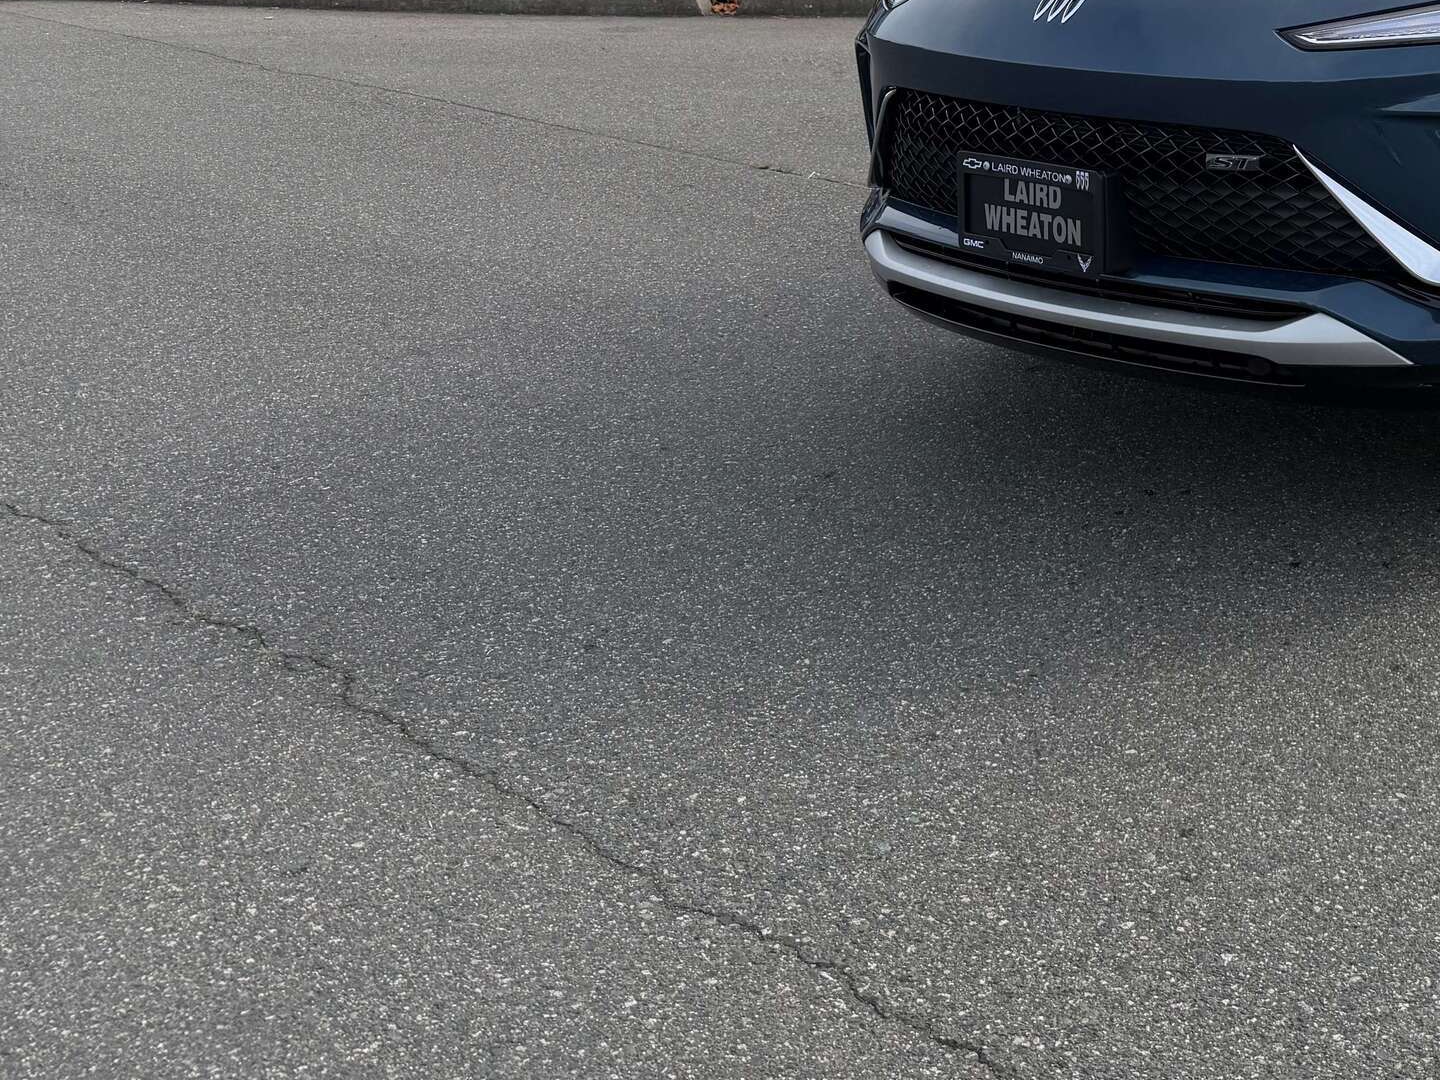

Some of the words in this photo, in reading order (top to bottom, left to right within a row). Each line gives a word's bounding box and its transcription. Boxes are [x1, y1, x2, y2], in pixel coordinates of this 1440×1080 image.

[991, 162, 1019, 175] LAIRD
[1020, 166, 1066, 184] WHEATON
[1003, 178, 1062, 209] LAIRD
[984, 203, 1081, 247] WHEATON
[963, 237, 985, 249] GMC
[1011, 251, 1044, 265] NANAIMO
